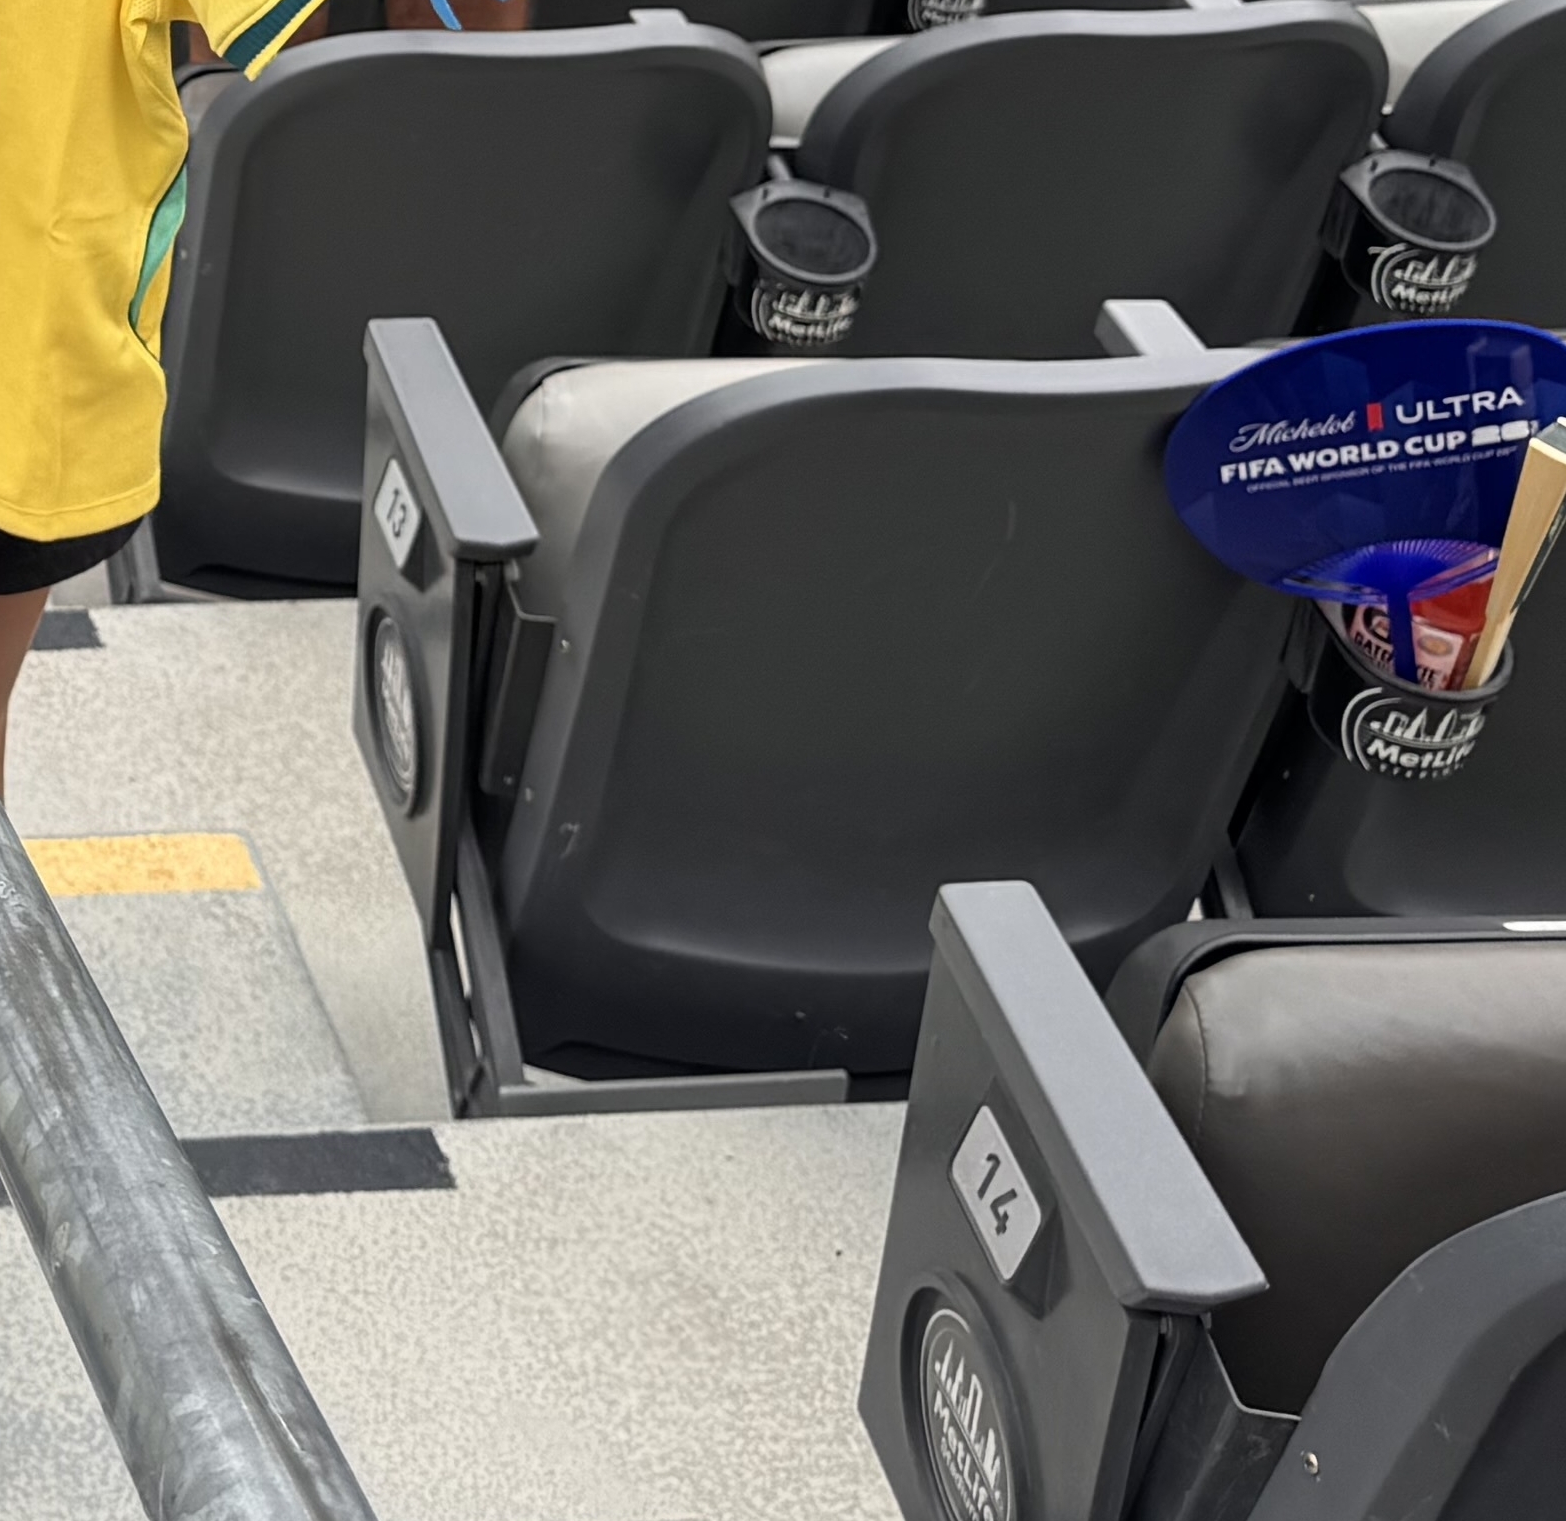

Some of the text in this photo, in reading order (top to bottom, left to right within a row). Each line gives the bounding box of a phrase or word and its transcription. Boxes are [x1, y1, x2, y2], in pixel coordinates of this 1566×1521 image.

[1229, 386, 1525, 453] Michelob ULTRA
[1220, 456, 1287, 484] FIFA
[1287, 440, 1400, 473] WORLD
[1404, 430, 1467, 457] CUP
[386, 487, 407, 538] 13
[977, 1152, 1018, 1237] 14
